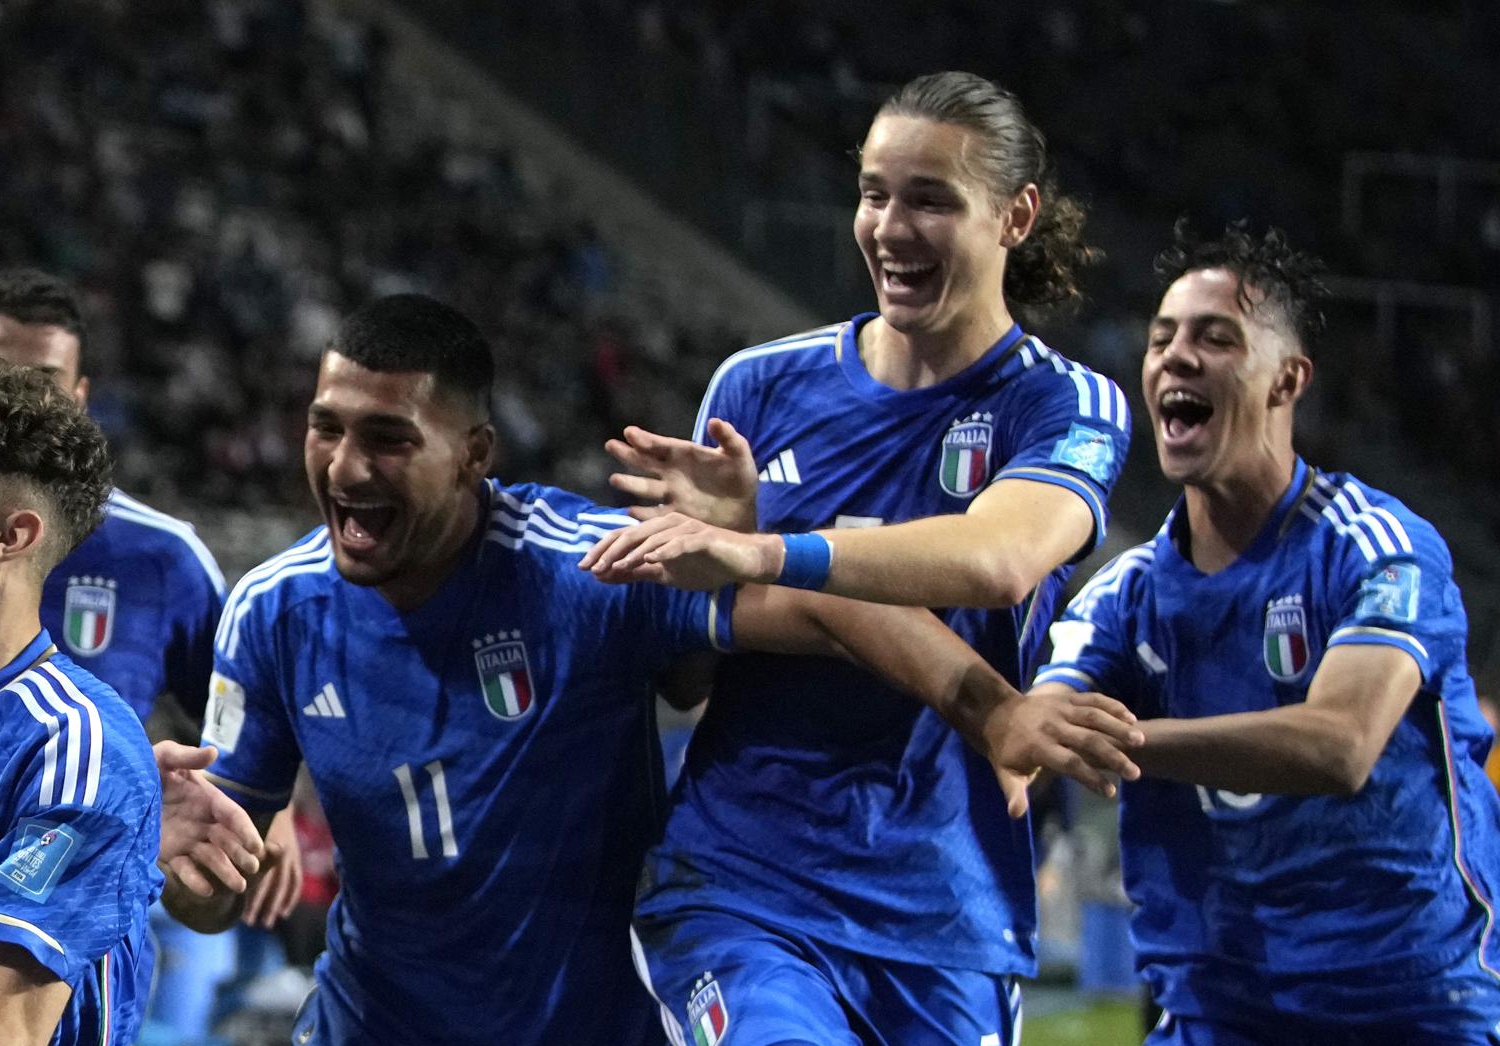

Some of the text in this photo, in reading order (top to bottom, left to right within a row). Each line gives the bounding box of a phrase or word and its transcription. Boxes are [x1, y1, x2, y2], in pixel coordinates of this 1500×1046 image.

[946, 428, 987, 444] ITALIA
[480, 647, 522, 671] ITALIA
[392, 760, 458, 859] 11
